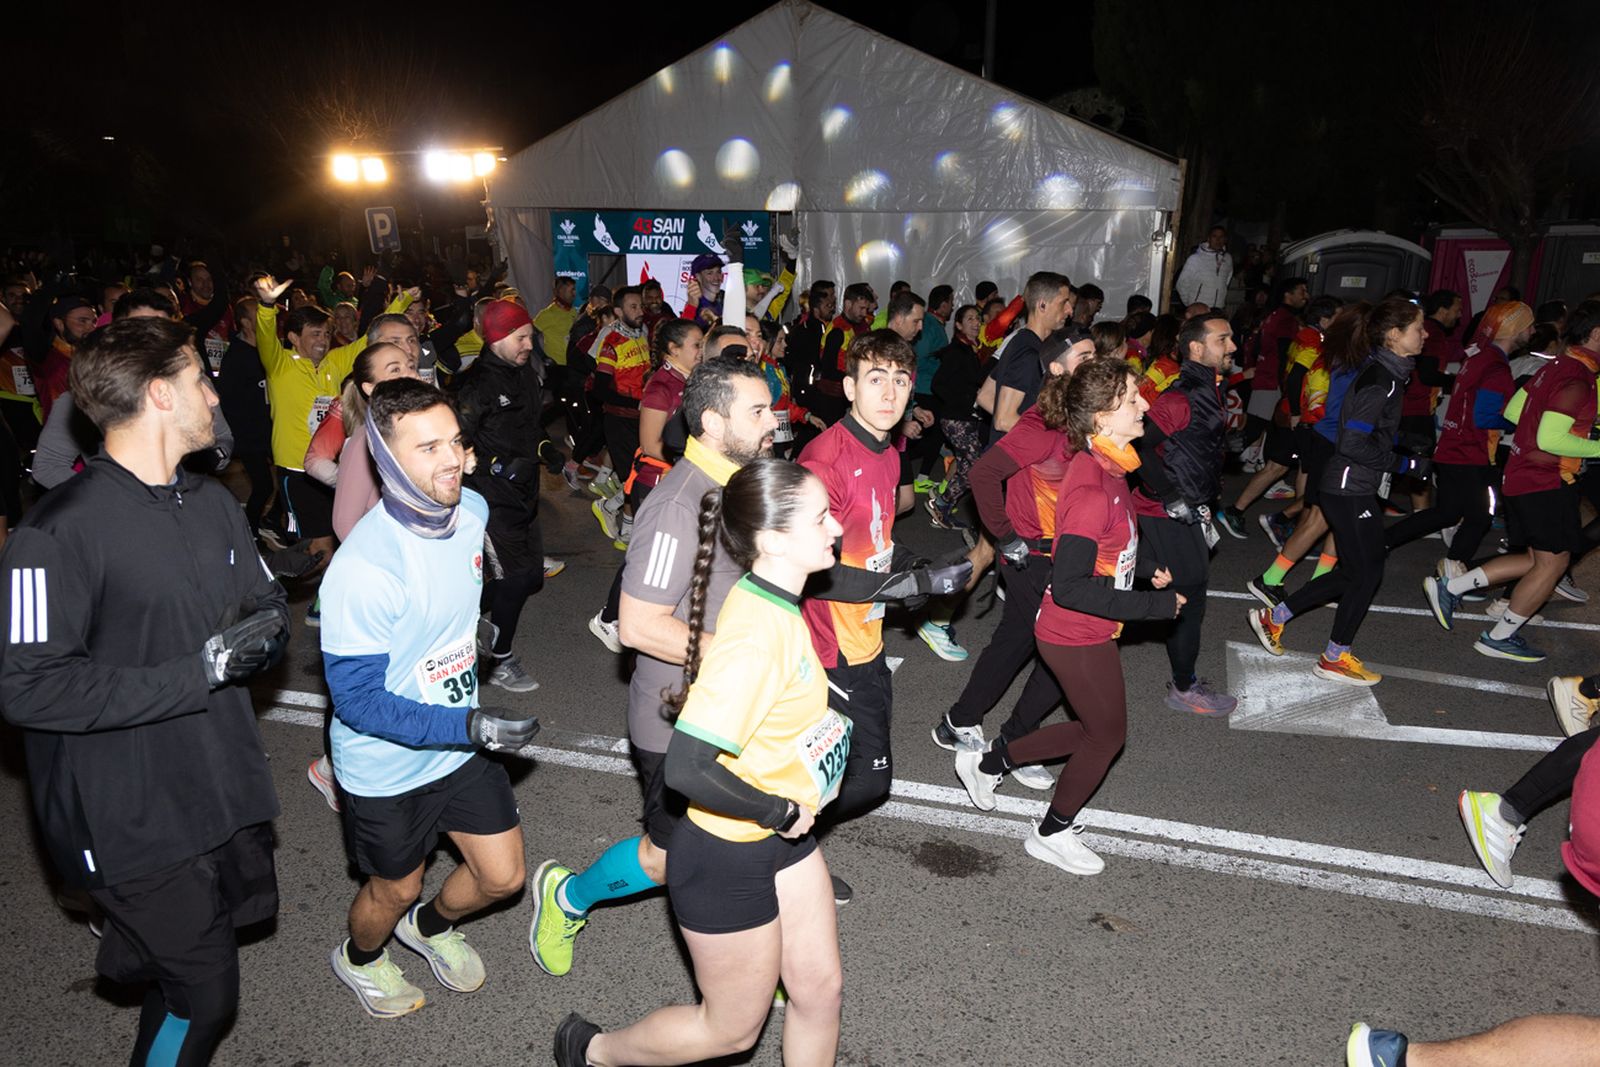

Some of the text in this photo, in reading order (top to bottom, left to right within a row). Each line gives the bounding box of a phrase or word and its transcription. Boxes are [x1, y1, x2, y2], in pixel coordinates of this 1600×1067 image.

[373, 213, 392, 247] P
[633, 216, 686, 235] 43 SAN
[629, 231, 684, 251] ANTÓN
[704, 235, 716, 248] 43
[437, 649, 465, 668] NOCHE
[429, 667, 449, 684] SAN
